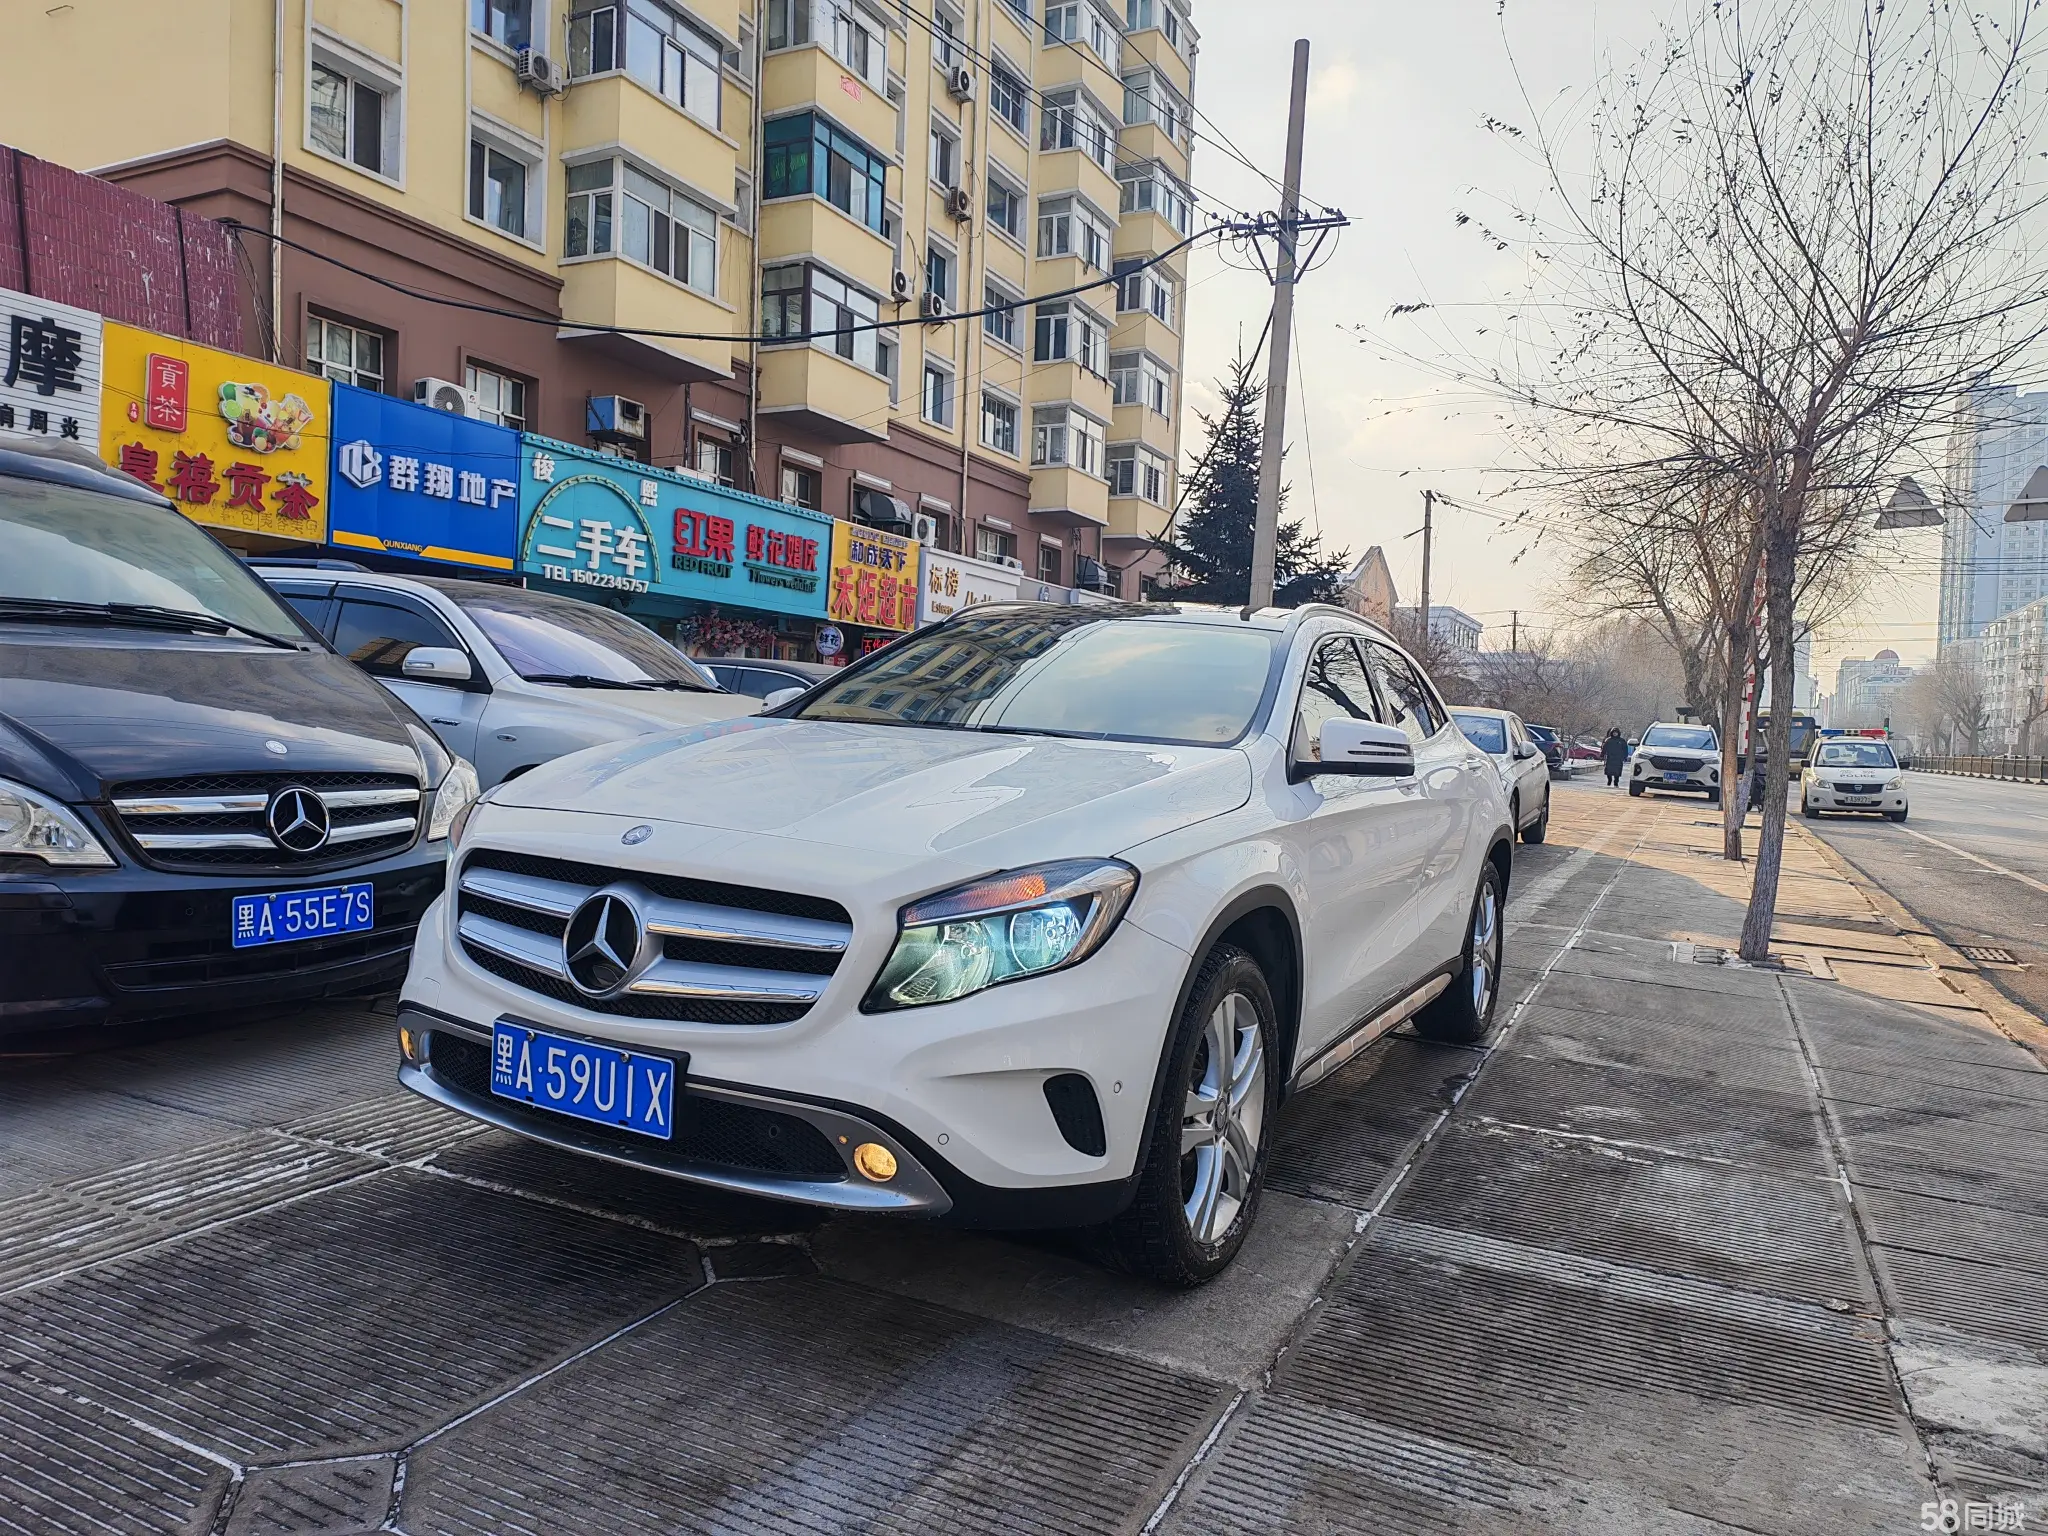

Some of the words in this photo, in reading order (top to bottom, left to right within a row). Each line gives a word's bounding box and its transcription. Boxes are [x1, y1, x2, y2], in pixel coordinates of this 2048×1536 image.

[4, 315, 82, 396] 摩
[154, 362, 183, 421] 貢茶
[389, 455, 516, 509] 群翔地产
[383, 539, 423, 552] QUNXIANG
[537, 515, 648, 576] 二手车
[673, 508, 735, 562] 红果
[745, 524, 819, 571] 鲜花婚庆
[542, 564, 571, 582] TEL
[571, 569, 650, 594] 15022345757
[673, 554, 699, 571] RED
[700, 560, 733, 578] FRUIT
[929, 563, 960, 598] 标榜
[238, 891, 370, 938] 黑A·55E7S
